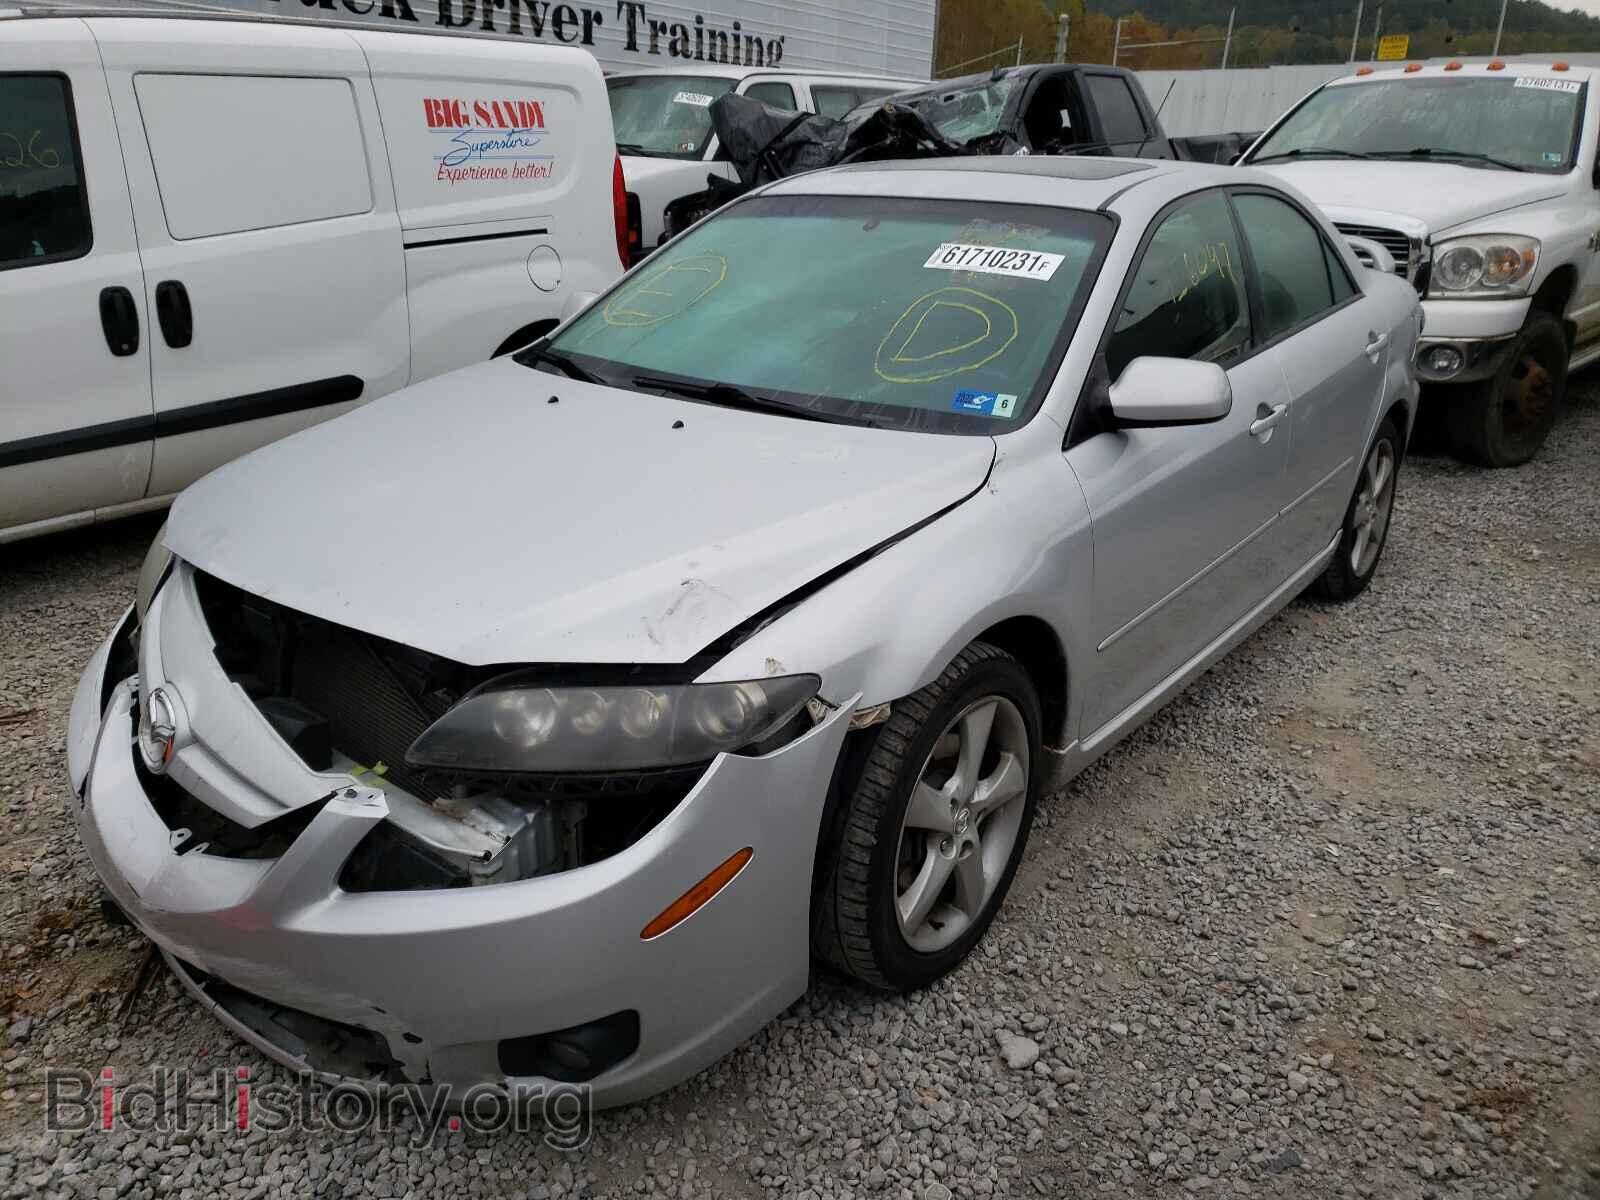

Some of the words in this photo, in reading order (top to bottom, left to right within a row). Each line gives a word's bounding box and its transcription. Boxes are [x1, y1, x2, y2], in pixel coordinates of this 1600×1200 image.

[617, 0, 785, 69] Training
[423, 98, 470, 128] BIG
[473, 100, 545, 128] SANDY
[443, 128, 542, 166] Superstore
[437, 162, 508, 184] Experience
[511, 160, 554, 180] better!
[1001, 399, 1009, 409] 6
